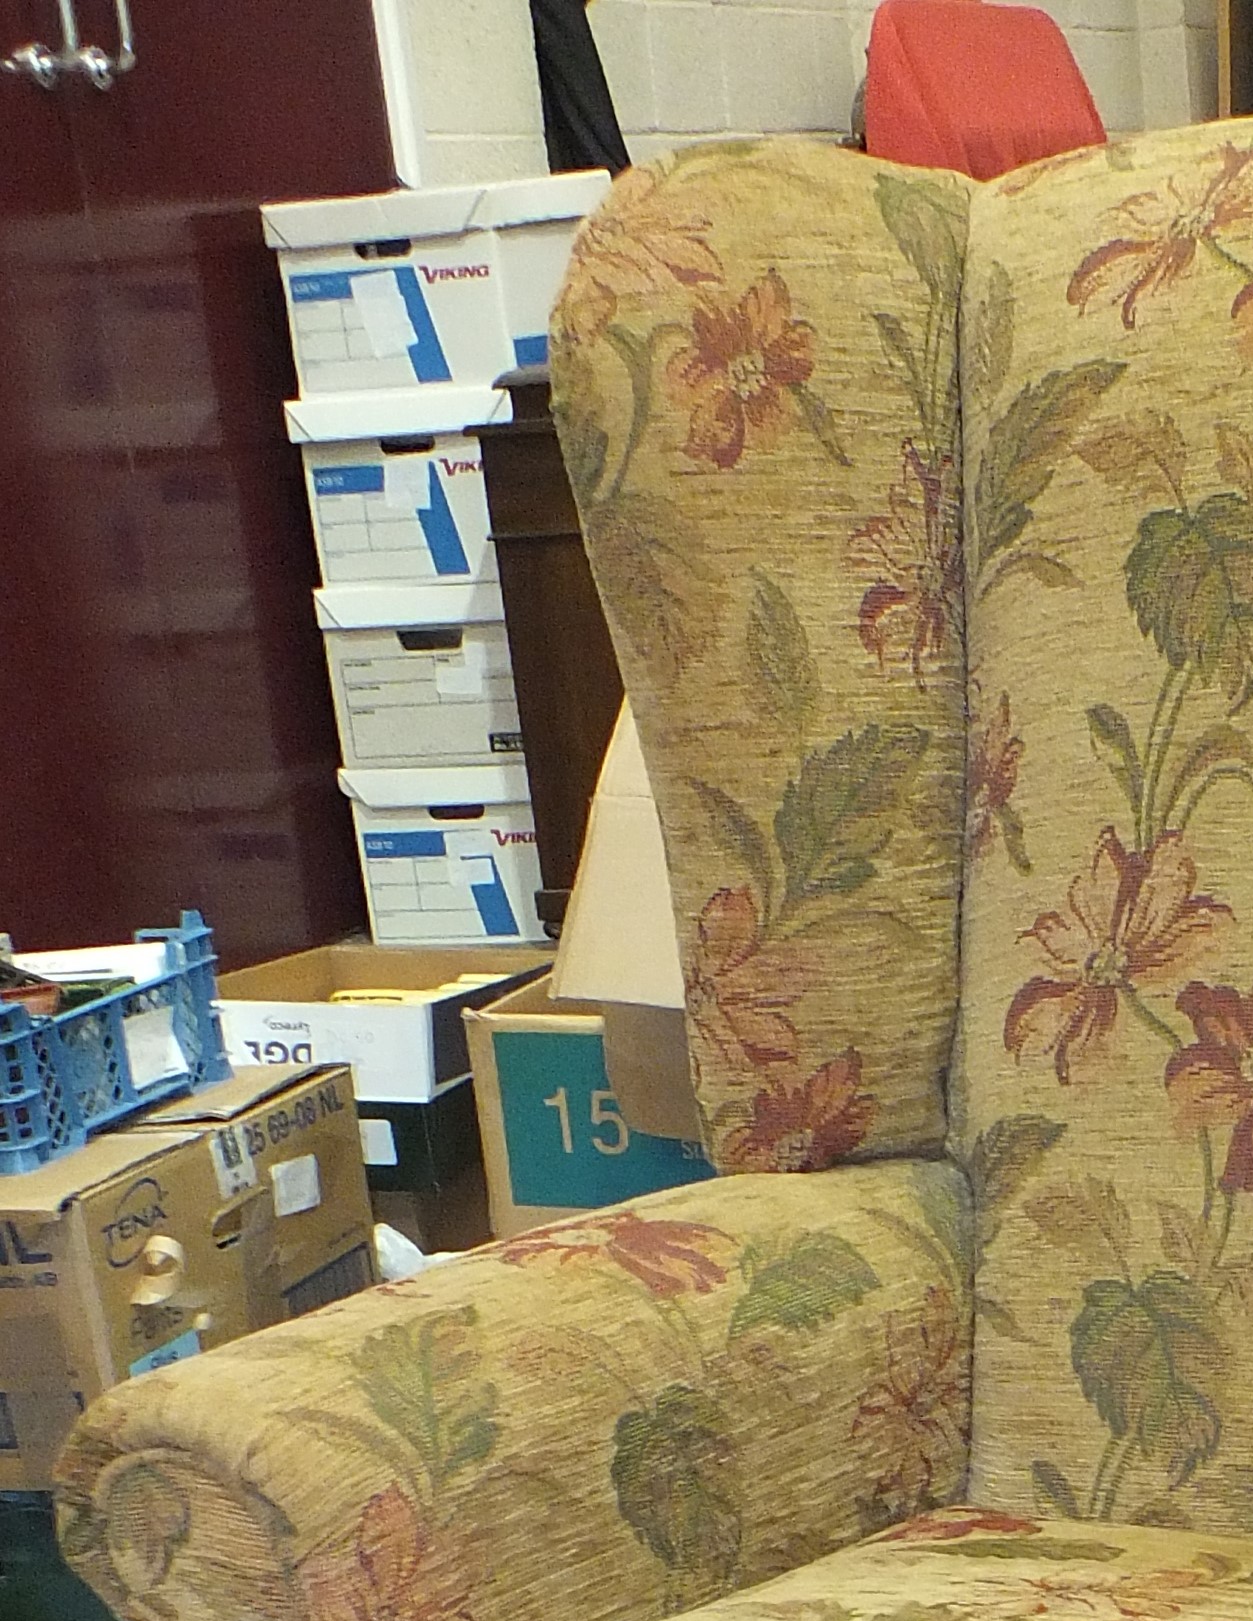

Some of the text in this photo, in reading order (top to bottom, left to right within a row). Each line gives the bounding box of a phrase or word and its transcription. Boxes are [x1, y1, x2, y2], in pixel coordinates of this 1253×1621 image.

[418, 264, 490, 285] VIKING
[438, 457, 484, 477] VIKI
[490, 828, 536, 847] VIKI
[543, 1087, 630, 1155] 15
[99, 1204, 168, 1242] TENA
